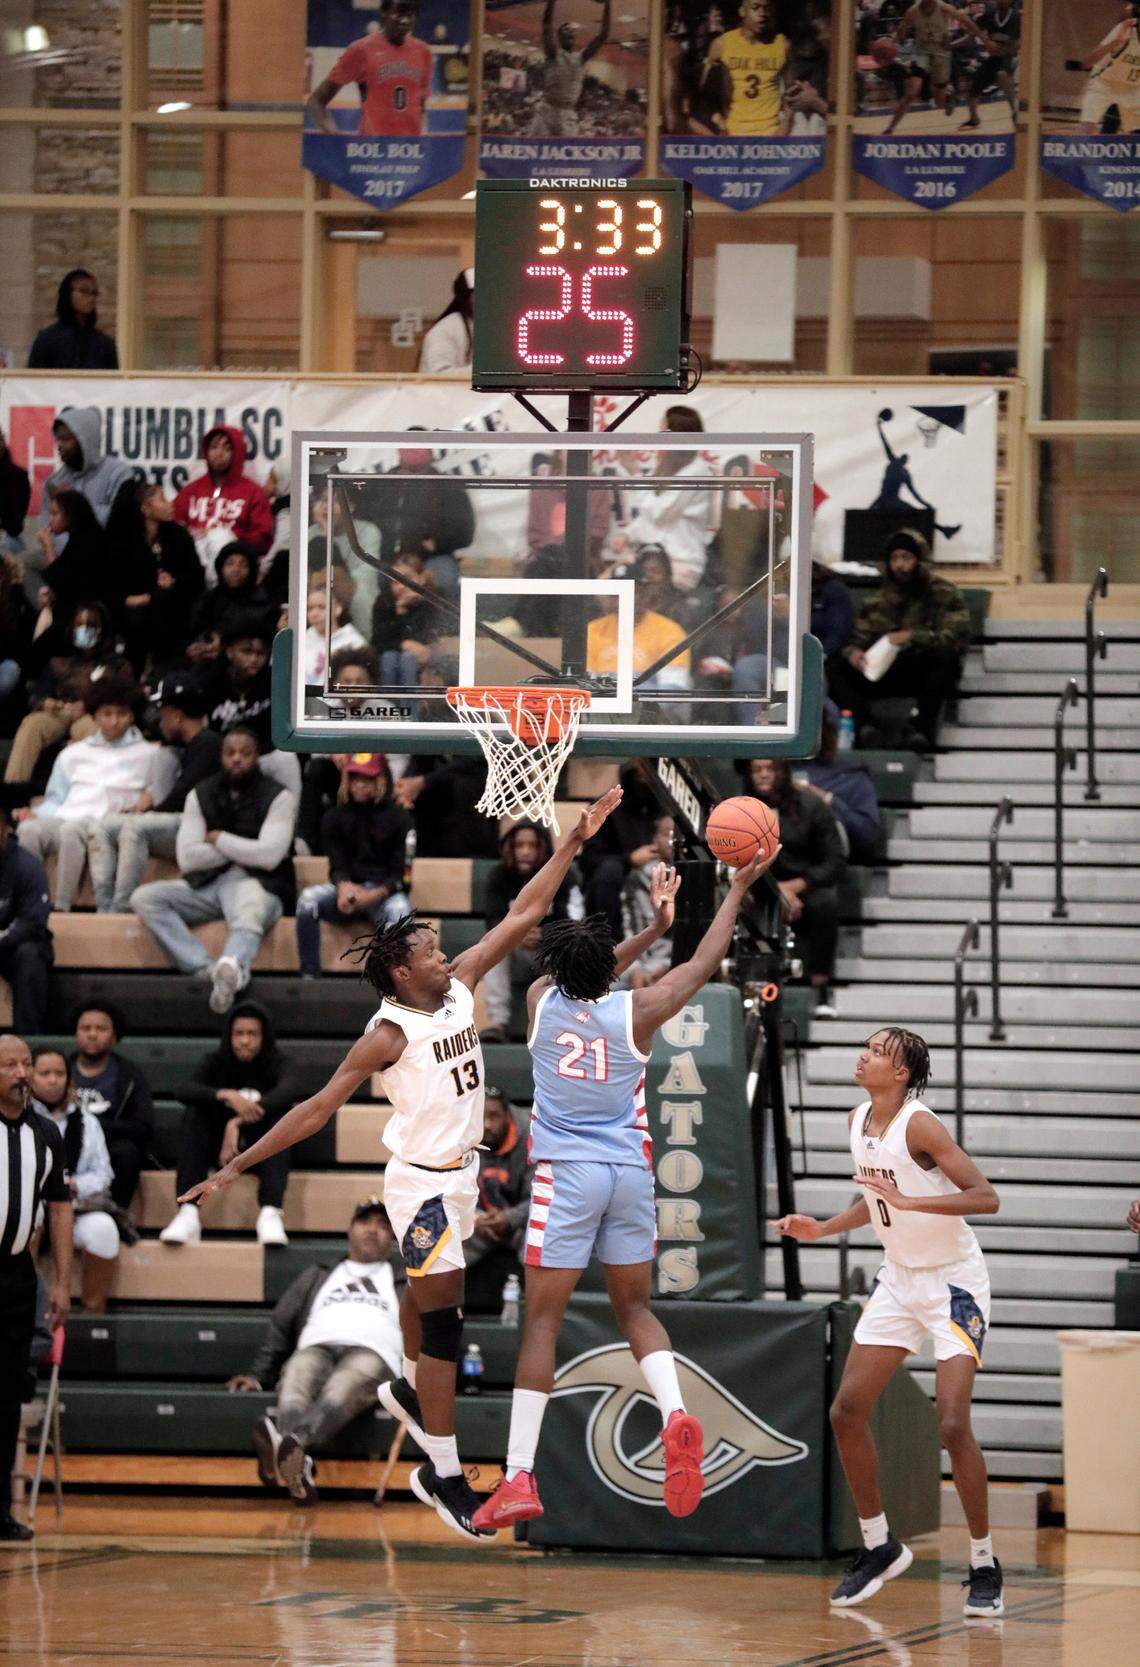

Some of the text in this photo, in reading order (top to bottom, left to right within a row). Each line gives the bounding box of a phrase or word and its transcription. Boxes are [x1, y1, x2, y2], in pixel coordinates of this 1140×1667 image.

[394, 85, 408, 112] 0
[745, 74, 760, 99] 3
[346, 143, 425, 158] BOL BOL
[480, 143, 538, 160] JAREN
[539, 145, 620, 161] JACKSON
[665, 144, 821, 159] KELDON JOHNSON
[863, 143, 1007, 158] JORDAN POOLE
[1043, 142, 1132, 158] BRANDON
[363, 180, 405, 197] 2017
[529, 178, 628, 188] DAKTRONICS
[721, 182, 764, 198] 2017
[914, 181, 957, 198] 2016
[538, 200, 663, 256] 3:33
[517, 265, 635, 367] 25
[241, 407, 283, 461] SC
[350, 707, 411, 716] GARED
[658, 757, 700, 835] GARED
[432, 1023, 479, 1064] RAIDERS
[555, 1031, 608, 1083] 21
[450, 1059, 480, 1097] 13
[655, 1004, 710, 1295] GATORS
[876, 1198, 892, 1228] 0
